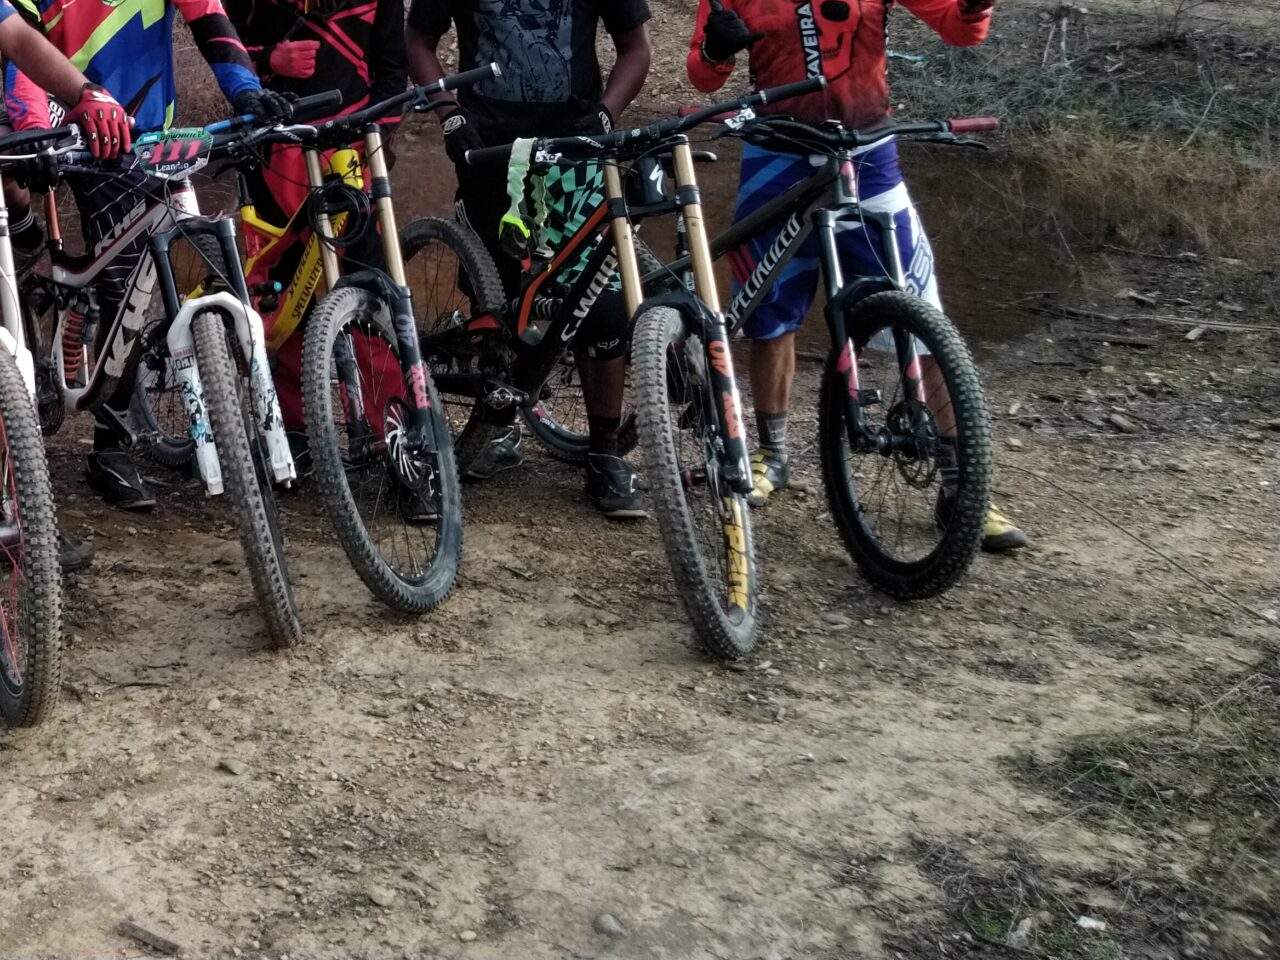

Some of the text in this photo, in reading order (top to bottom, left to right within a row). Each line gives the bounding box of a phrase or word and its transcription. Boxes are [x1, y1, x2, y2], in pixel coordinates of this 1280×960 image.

[149, 139, 203, 164] 111
[160, 131, 205, 141] DOWNHILL
[94, 198, 147, 259] KHS
[724, 213, 802, 331] SPECIALIZED
[103, 249, 158, 378] KHS
[410, 364, 433, 409] FOX
[721, 390, 746, 440] FOX
